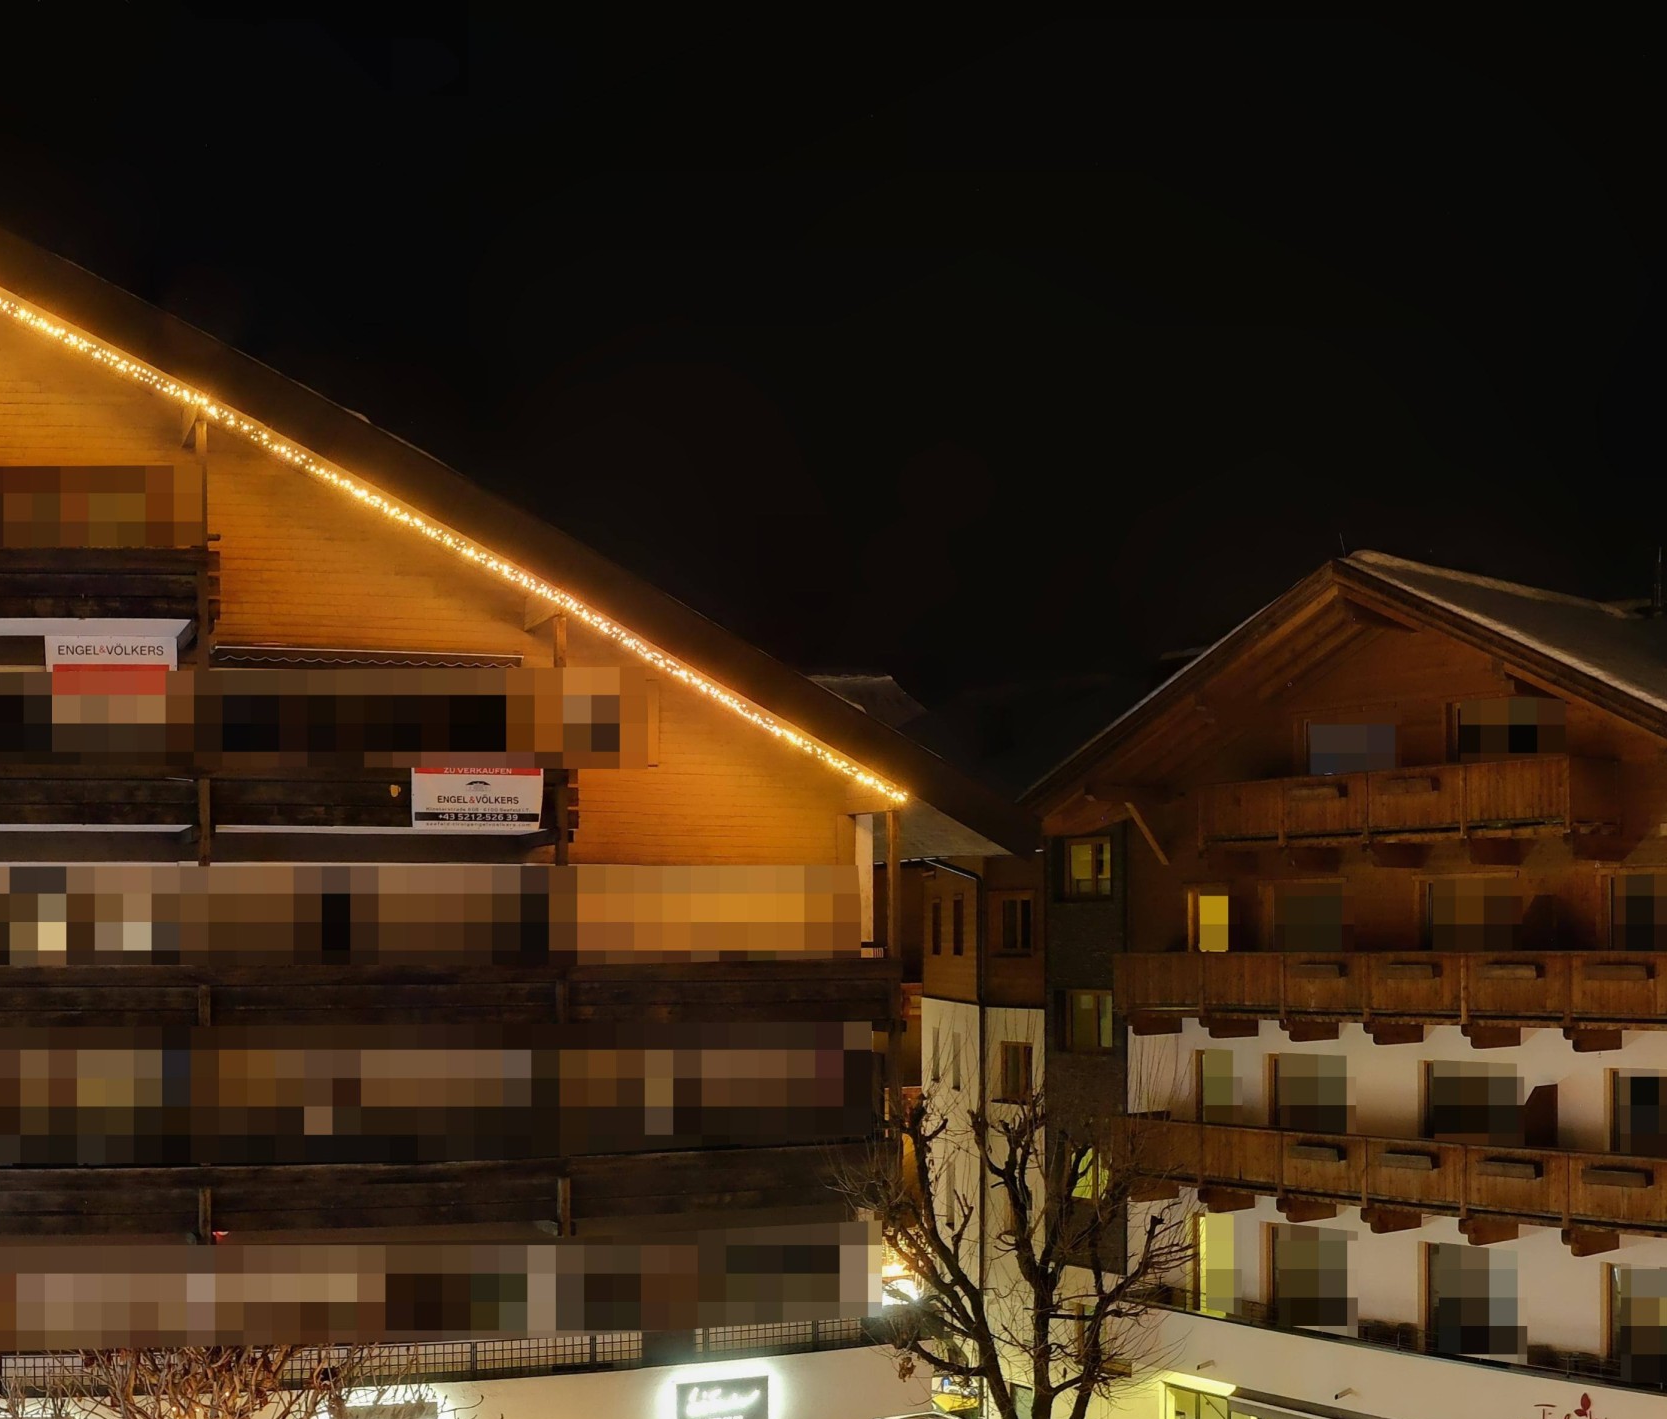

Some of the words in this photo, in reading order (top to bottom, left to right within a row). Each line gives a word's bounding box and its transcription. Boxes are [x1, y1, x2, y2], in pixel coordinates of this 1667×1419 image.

[57, 643, 164, 656] ENGEL&VÖLKERS
[437, 794, 520, 805] ENGEL&VÖLKERS
[438, 813, 455, 821] +43
